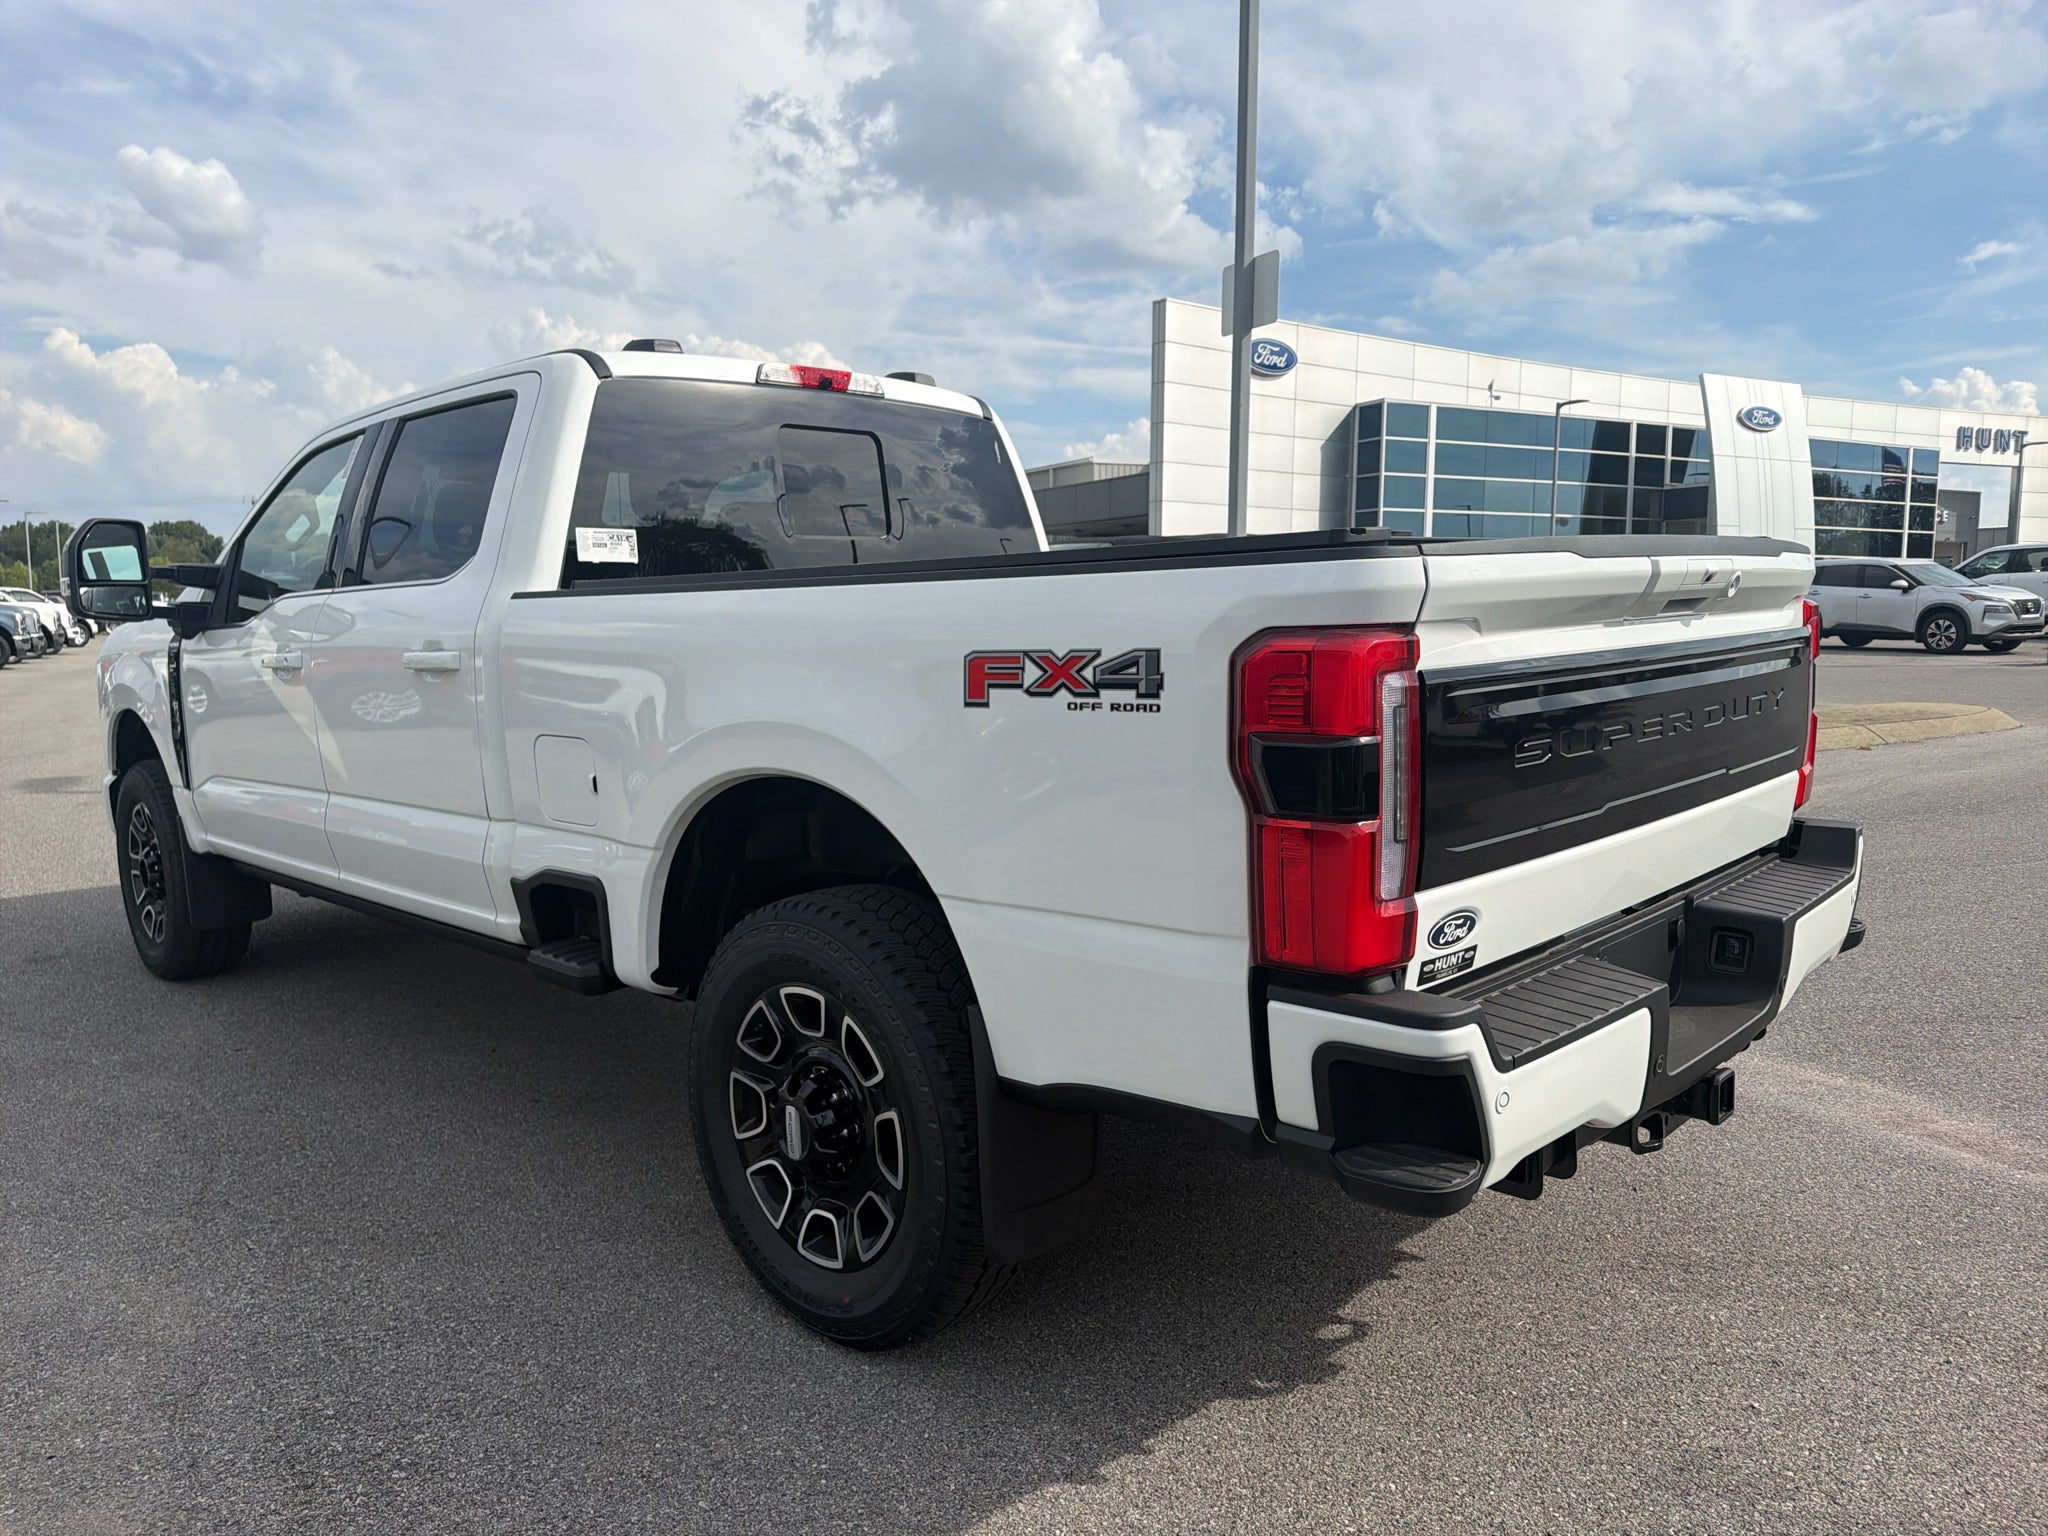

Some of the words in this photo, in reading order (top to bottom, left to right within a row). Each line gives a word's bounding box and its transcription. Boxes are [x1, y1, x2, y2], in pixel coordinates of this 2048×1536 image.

[1253, 343, 1289, 368] Ford
[1752, 410, 1775, 424] Ford
[1956, 426, 2029, 455] HUNT
[963, 648, 1165, 708] FX4
[1067, 702, 1103, 712] OFF
[1110, 703, 1161, 713] ROAD
[1514, 708, 1693, 768] SUPER
[1703, 687, 1785, 728] DUTY
[1439, 918, 1471, 944] Ford
[1434, 951, 1466, 972] HUNT
